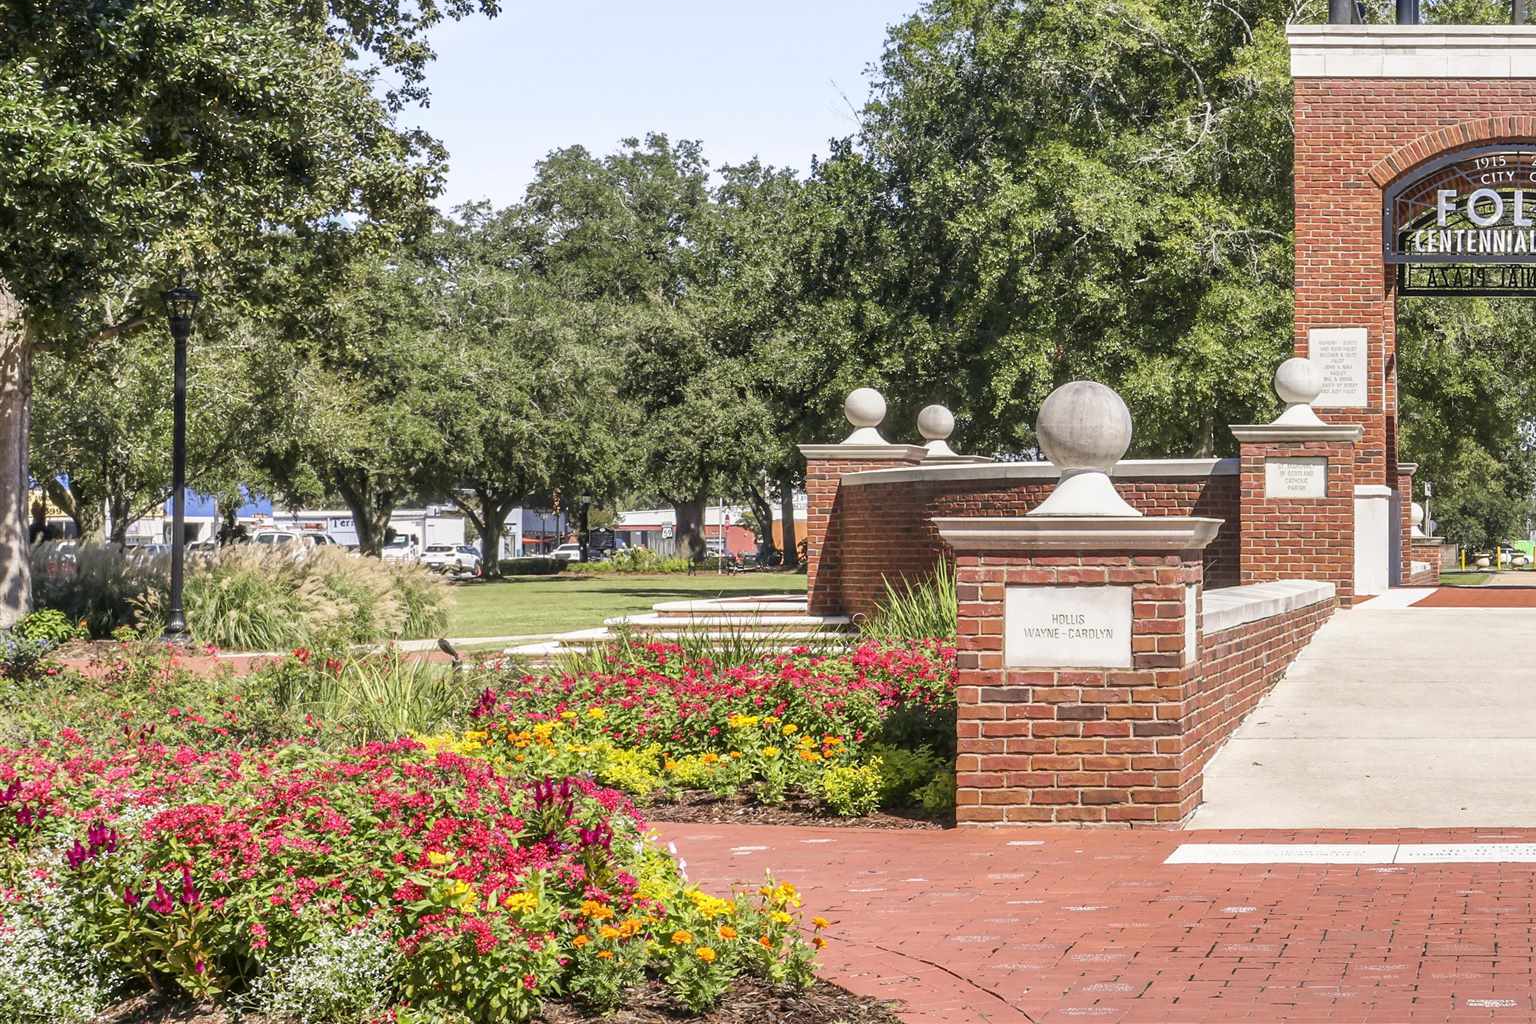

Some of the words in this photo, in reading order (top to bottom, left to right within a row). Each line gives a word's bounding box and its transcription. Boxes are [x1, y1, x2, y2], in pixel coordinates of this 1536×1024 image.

[1475, 155, 1507, 170] 1915
[1480, 170, 1515, 185] CITY
[1051, 614, 1086, 625] HOLLIS
